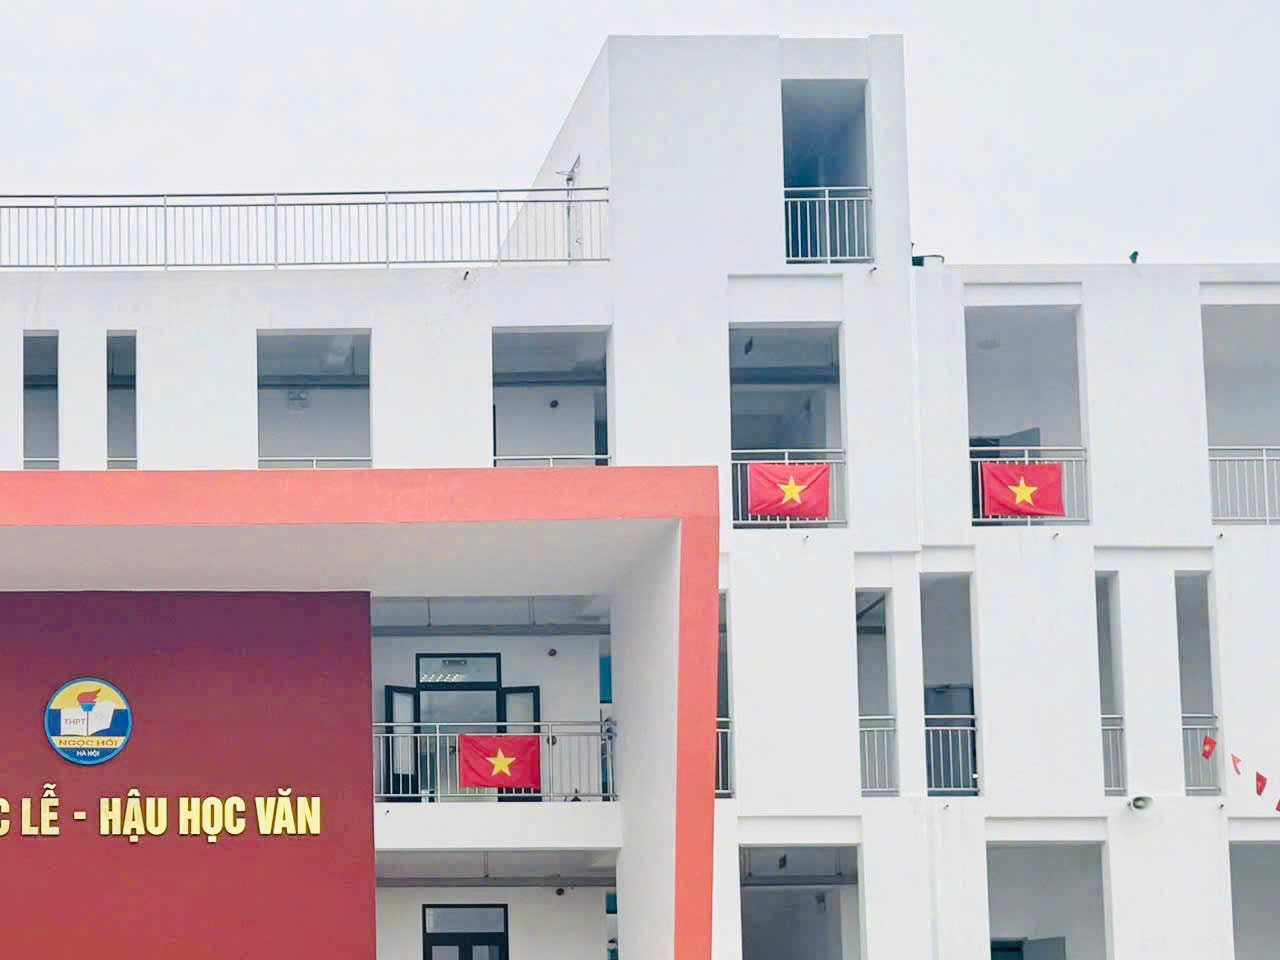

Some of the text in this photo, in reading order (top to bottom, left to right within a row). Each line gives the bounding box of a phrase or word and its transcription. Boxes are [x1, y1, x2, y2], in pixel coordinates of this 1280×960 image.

[21, 782, 60, 836] LỄ
[99, 788, 168, 843] HẬU
[179, 796, 247, 843] HỌC
[255, 787, 321, 835] VĂN
